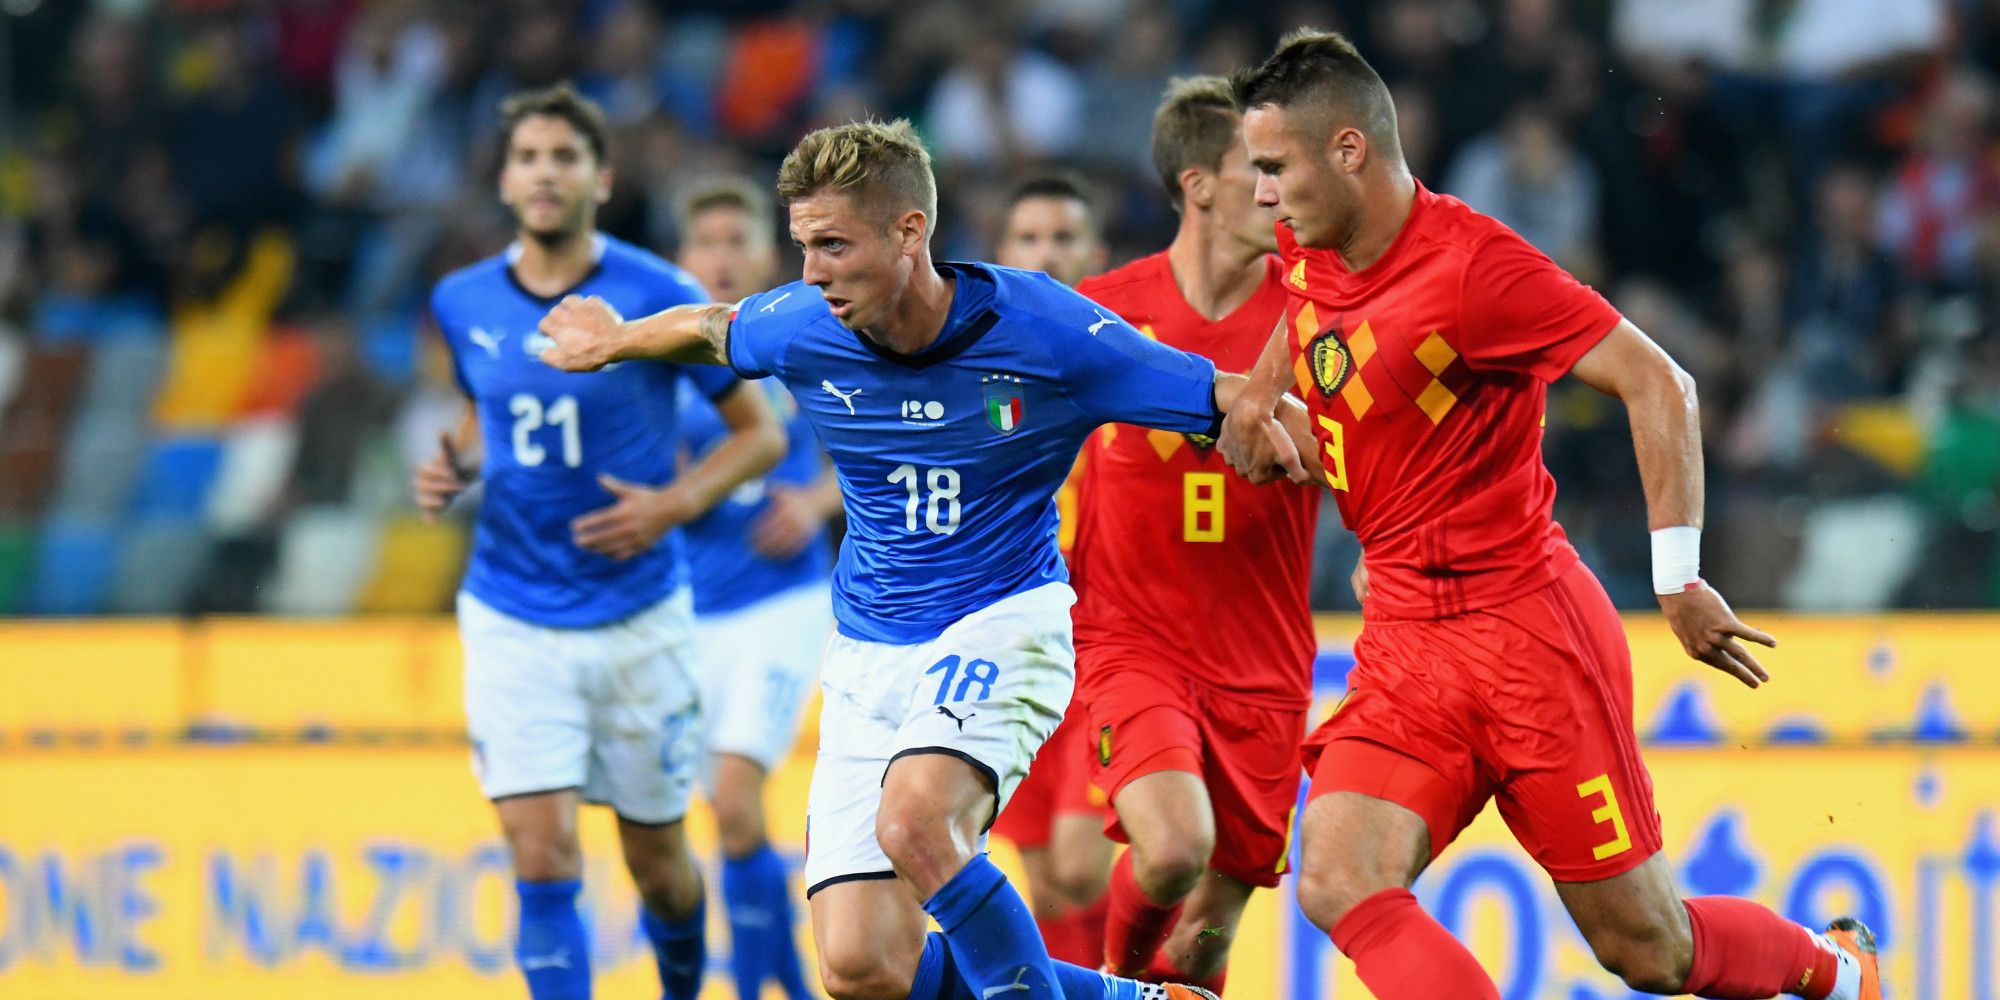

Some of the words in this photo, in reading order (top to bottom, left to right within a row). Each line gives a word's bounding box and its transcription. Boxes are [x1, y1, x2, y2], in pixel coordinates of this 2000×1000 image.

[508, 394, 582, 467] 21
[1318, 414, 1349, 493] 3
[886, 464, 961, 535] 18
[1183, 472, 1225, 543] 8
[925, 654, 1000, 705] 18
[1576, 773, 1632, 861] 3
